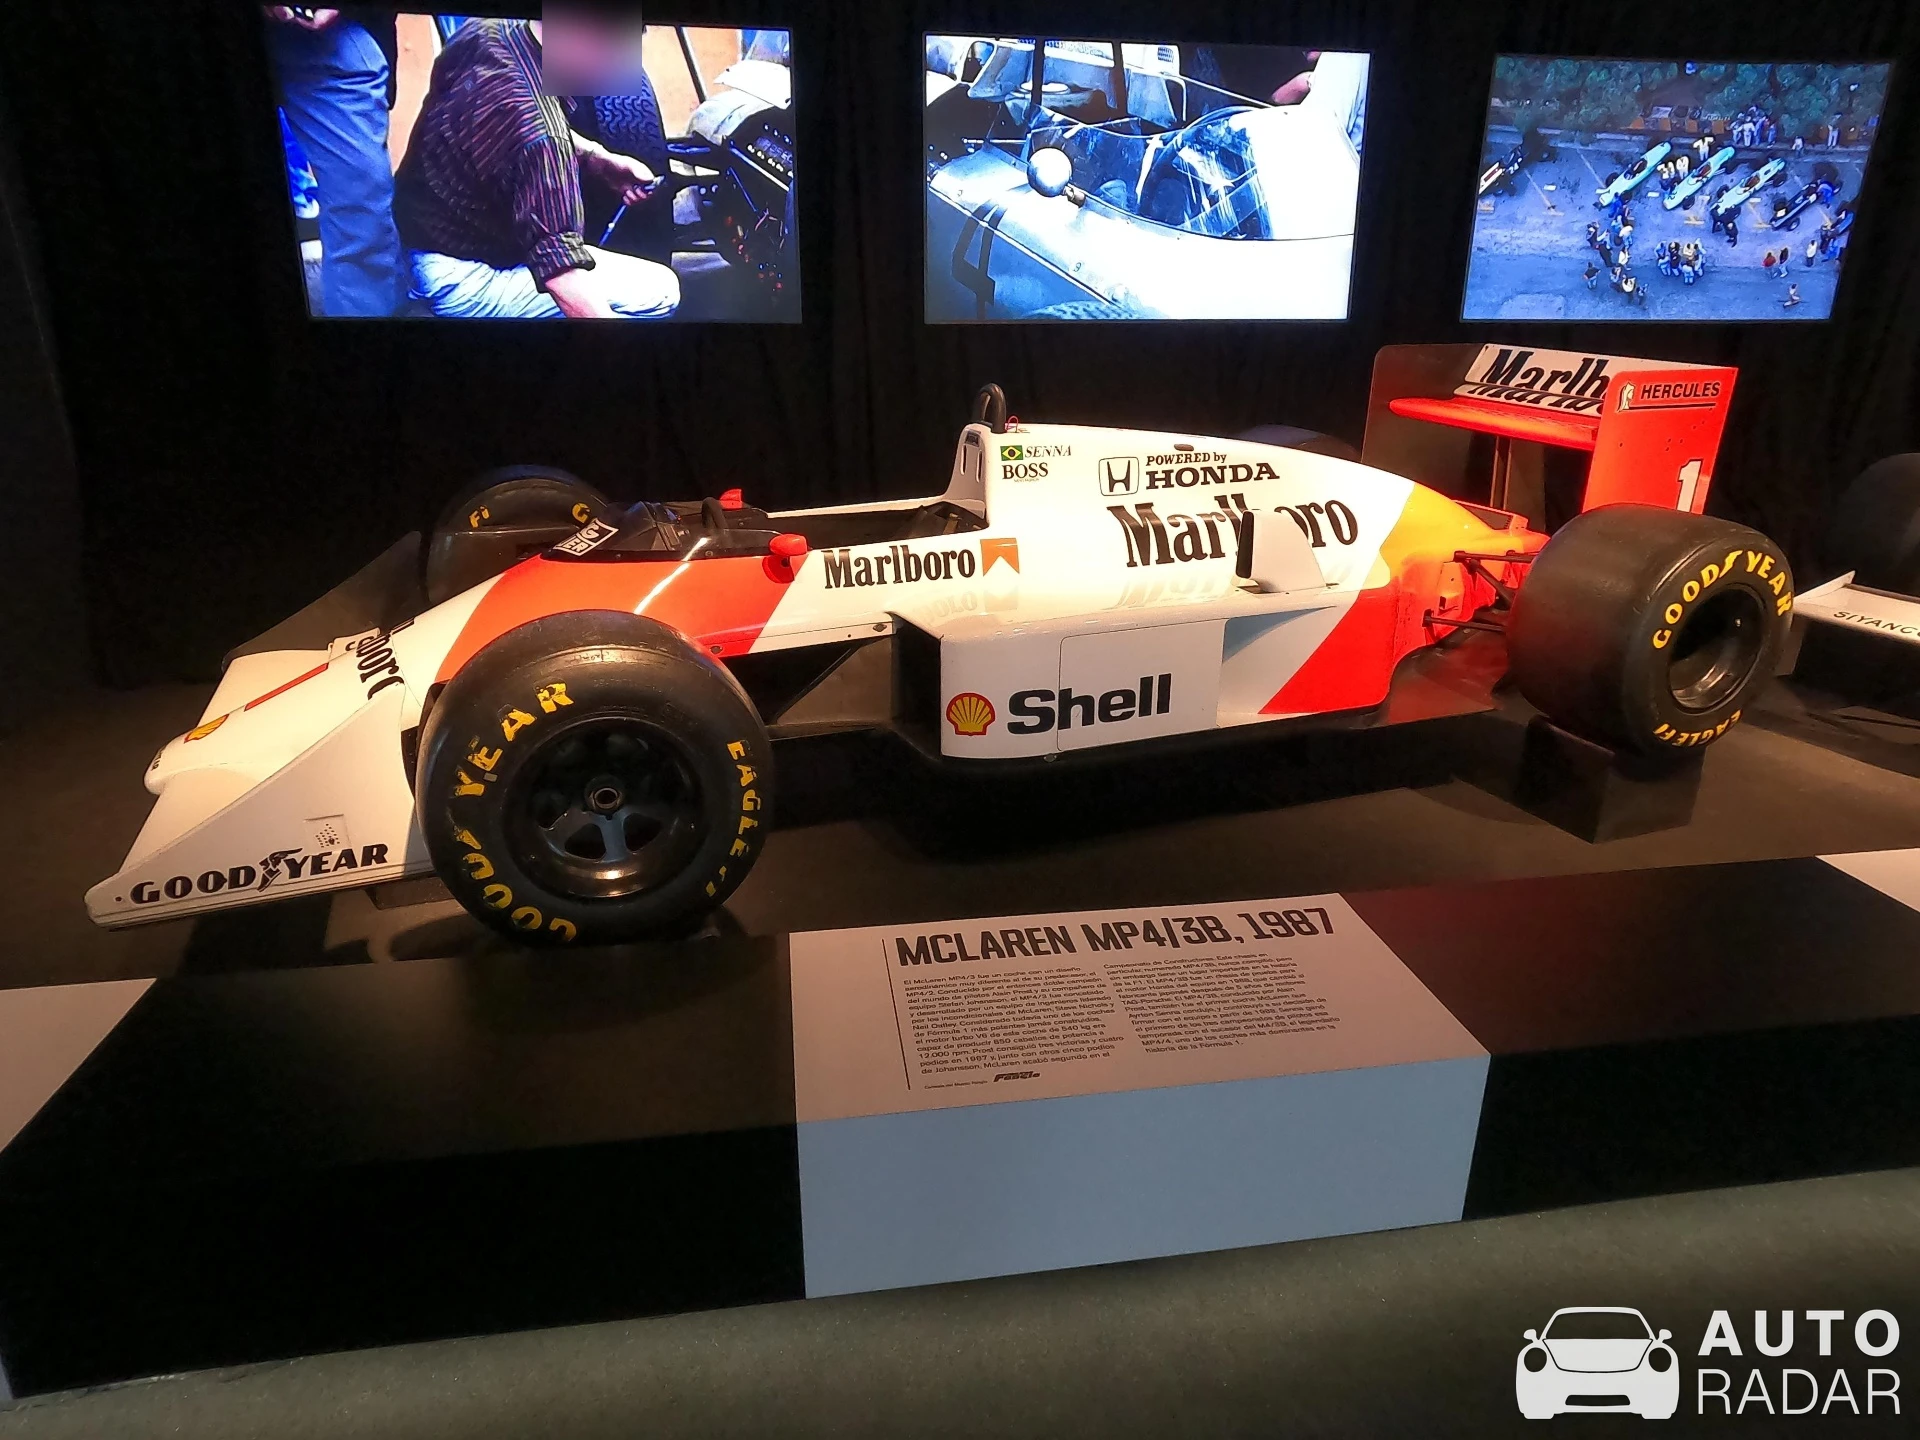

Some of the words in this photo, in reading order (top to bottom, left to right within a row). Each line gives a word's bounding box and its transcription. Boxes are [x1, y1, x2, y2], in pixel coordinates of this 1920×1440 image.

[1641, 382, 1721, 400] HERCULES
[1024, 445, 1071, 458] SENNA
[1146, 452, 1210, 466] POWERED
[1213, 452, 1227, 465] by
[1001, 462, 1048, 480] BOSS
[1146, 462, 1280, 490] HONDA
[823, 545, 975, 590] Marlboro
[1006, 673, 1172, 736] Shell
[895, 925, 1072, 966] MCLAREN
[1238, 907, 1336, 941] 1987
